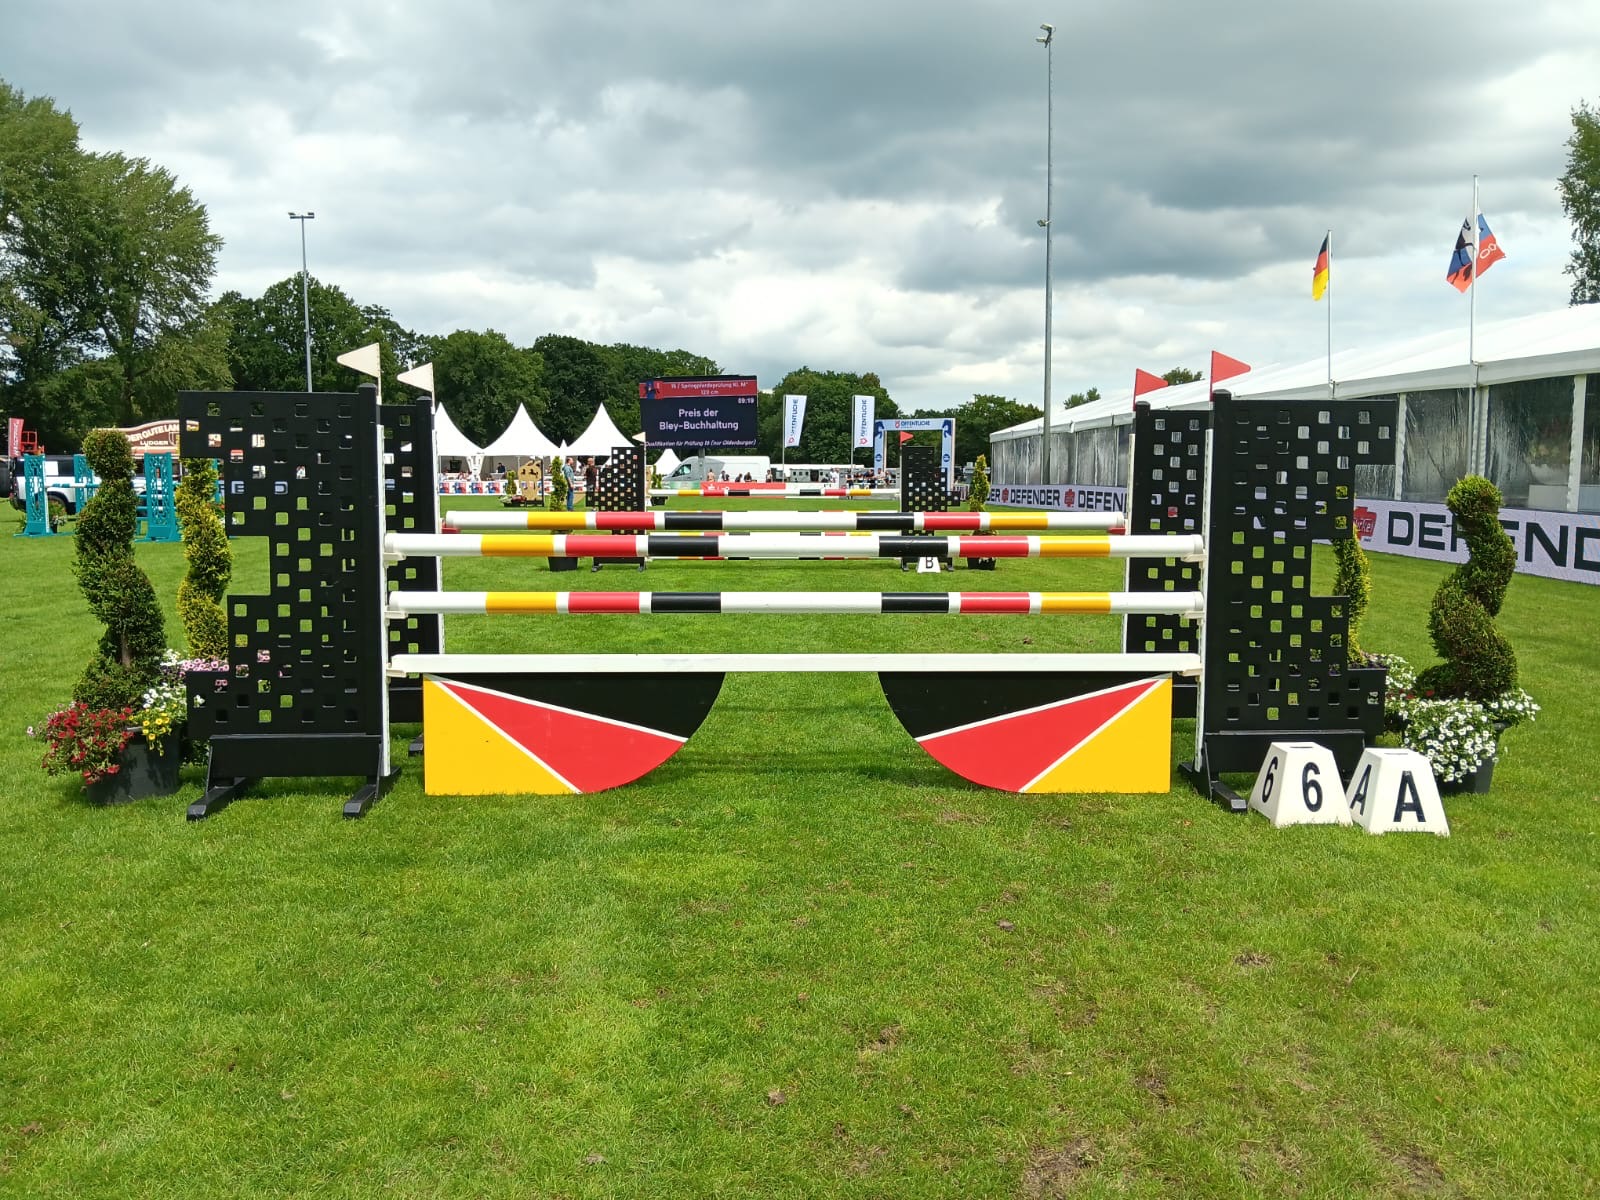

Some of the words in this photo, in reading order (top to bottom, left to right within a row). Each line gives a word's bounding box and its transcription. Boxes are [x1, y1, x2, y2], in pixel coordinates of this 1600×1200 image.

[678, 408, 702, 418] Preis
[703, 407, 719, 417] der
[659, 419, 739, 432] Bley-Buchhaltung
[1010, 489, 1060, 507] DEFENDER
[1078, 490, 1127, 513] DEFEN
[925, 557, 934, 569] B
[1261, 756, 1278, 803] 6
[1302, 761, 1323, 812] 6
[1350, 764, 1372, 816] A
[1393, 770, 1427, 823] A
